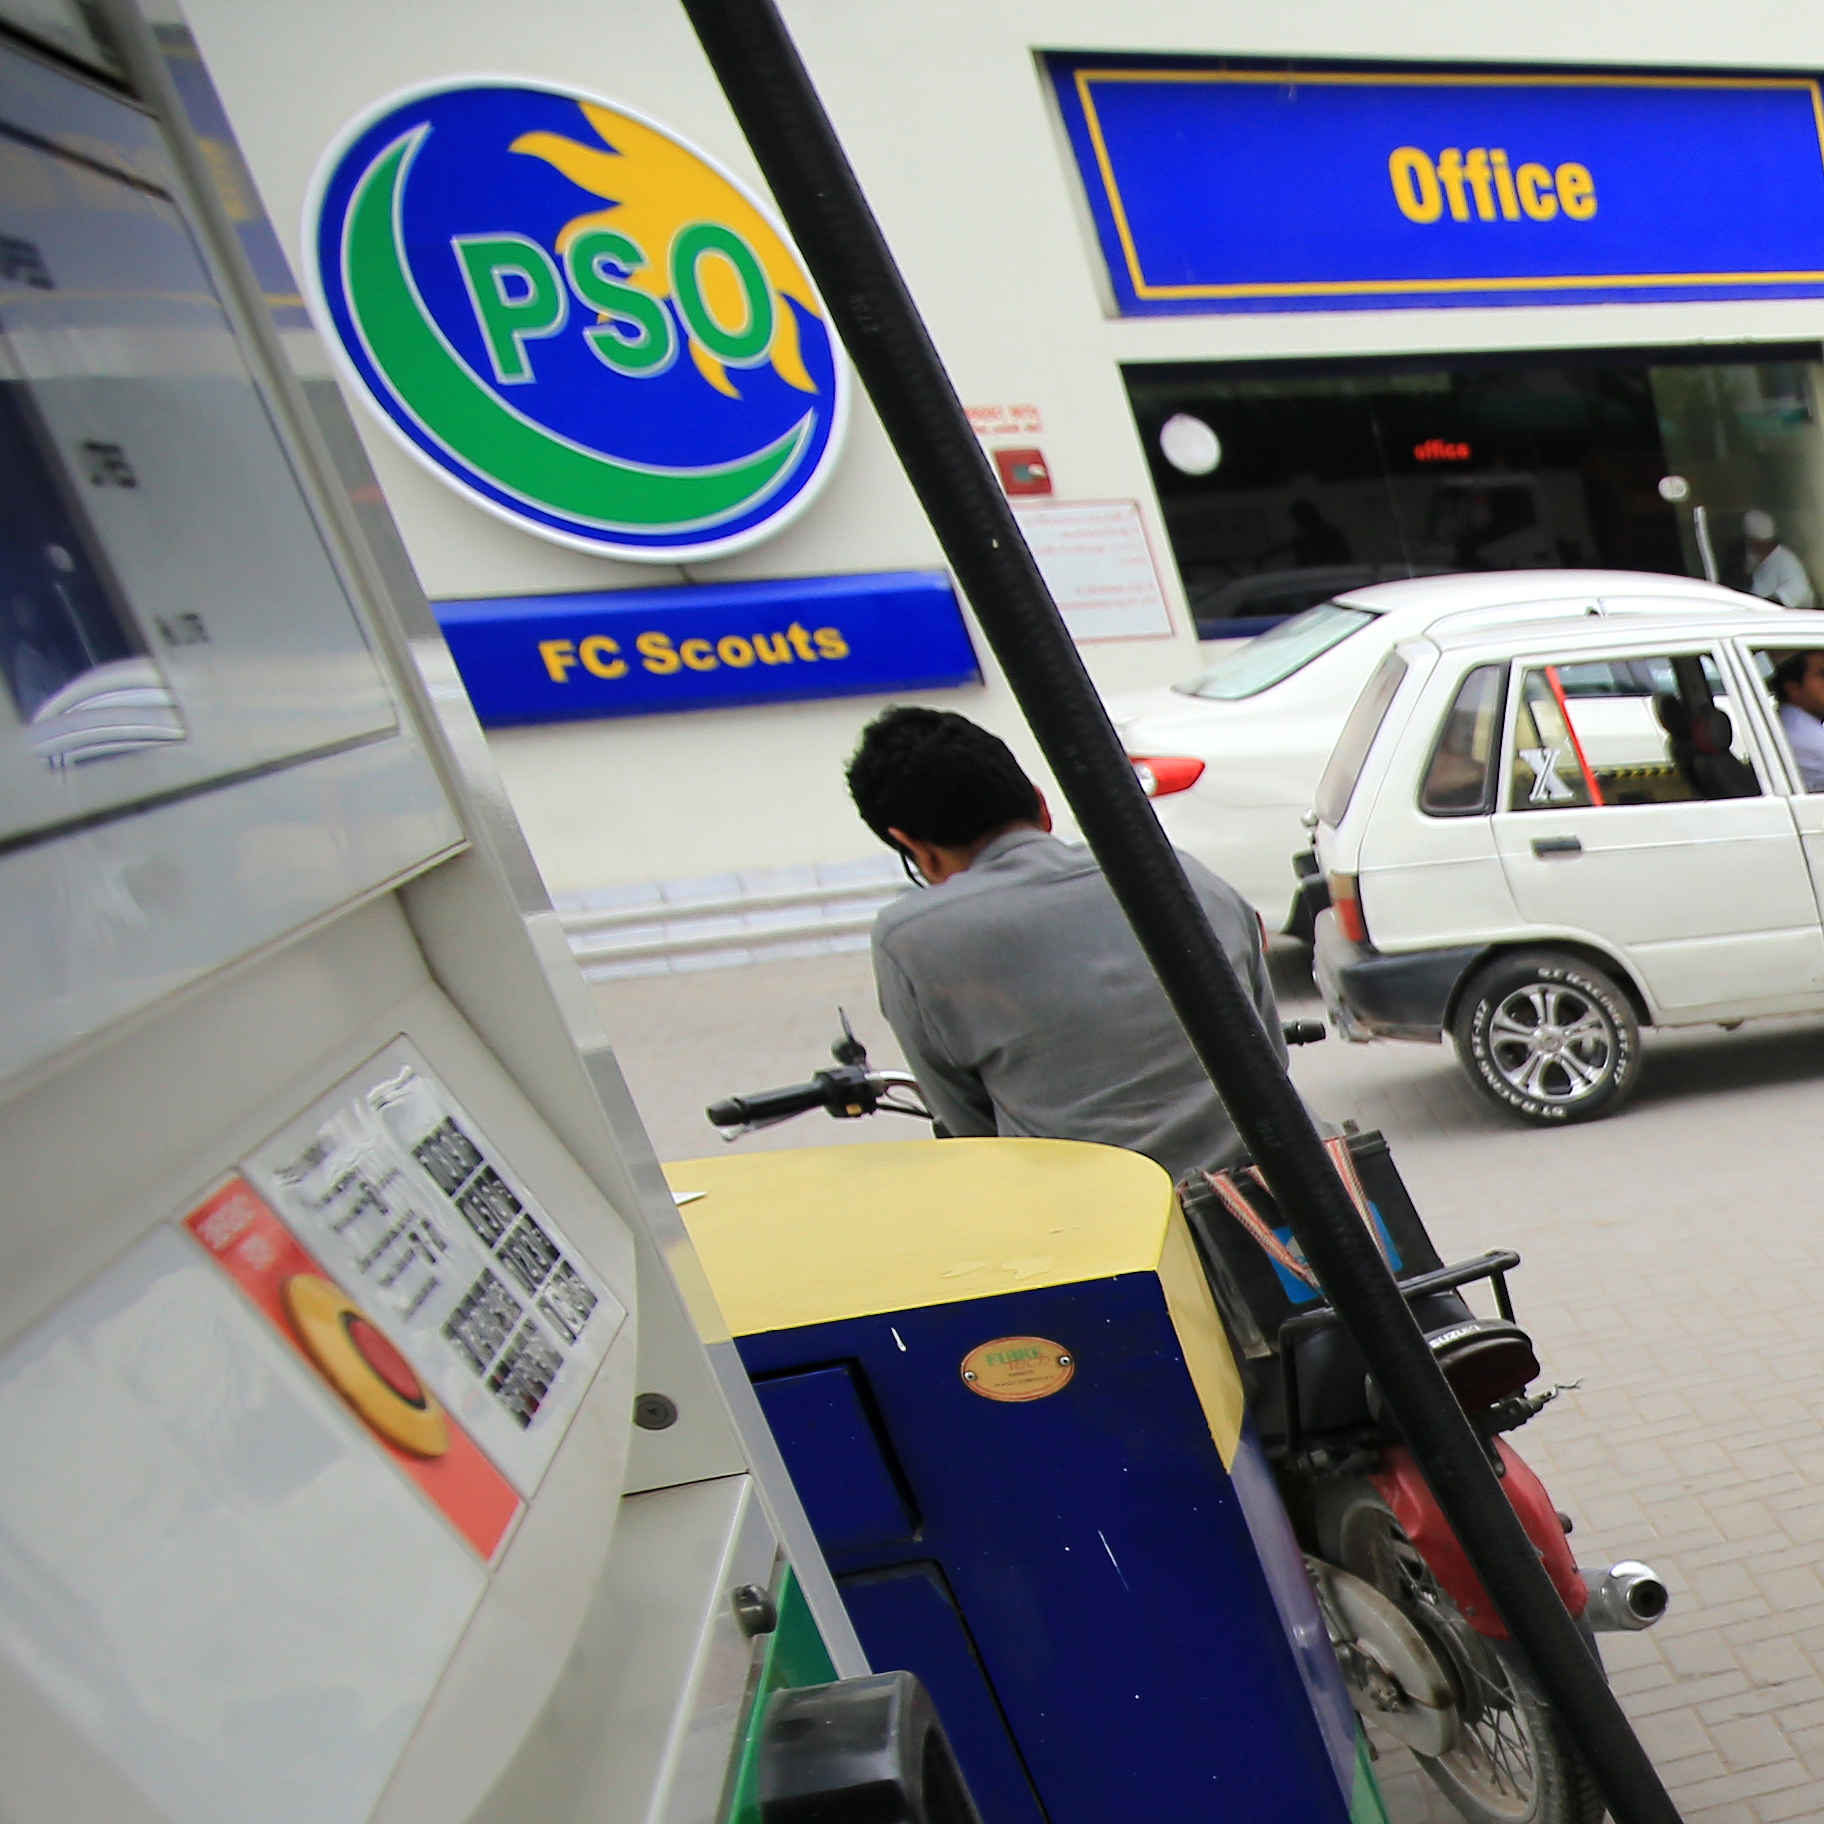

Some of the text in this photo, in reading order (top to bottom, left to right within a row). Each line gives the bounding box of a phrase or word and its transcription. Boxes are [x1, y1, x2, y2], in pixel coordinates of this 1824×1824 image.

[1388, 145, 1598, 224] Office
[451, 220, 777, 386] PSO
[1413, 438, 1471, 462] office
[538, 619, 850, 686] FC Scouts
[1518, 747, 1575, 802] X
